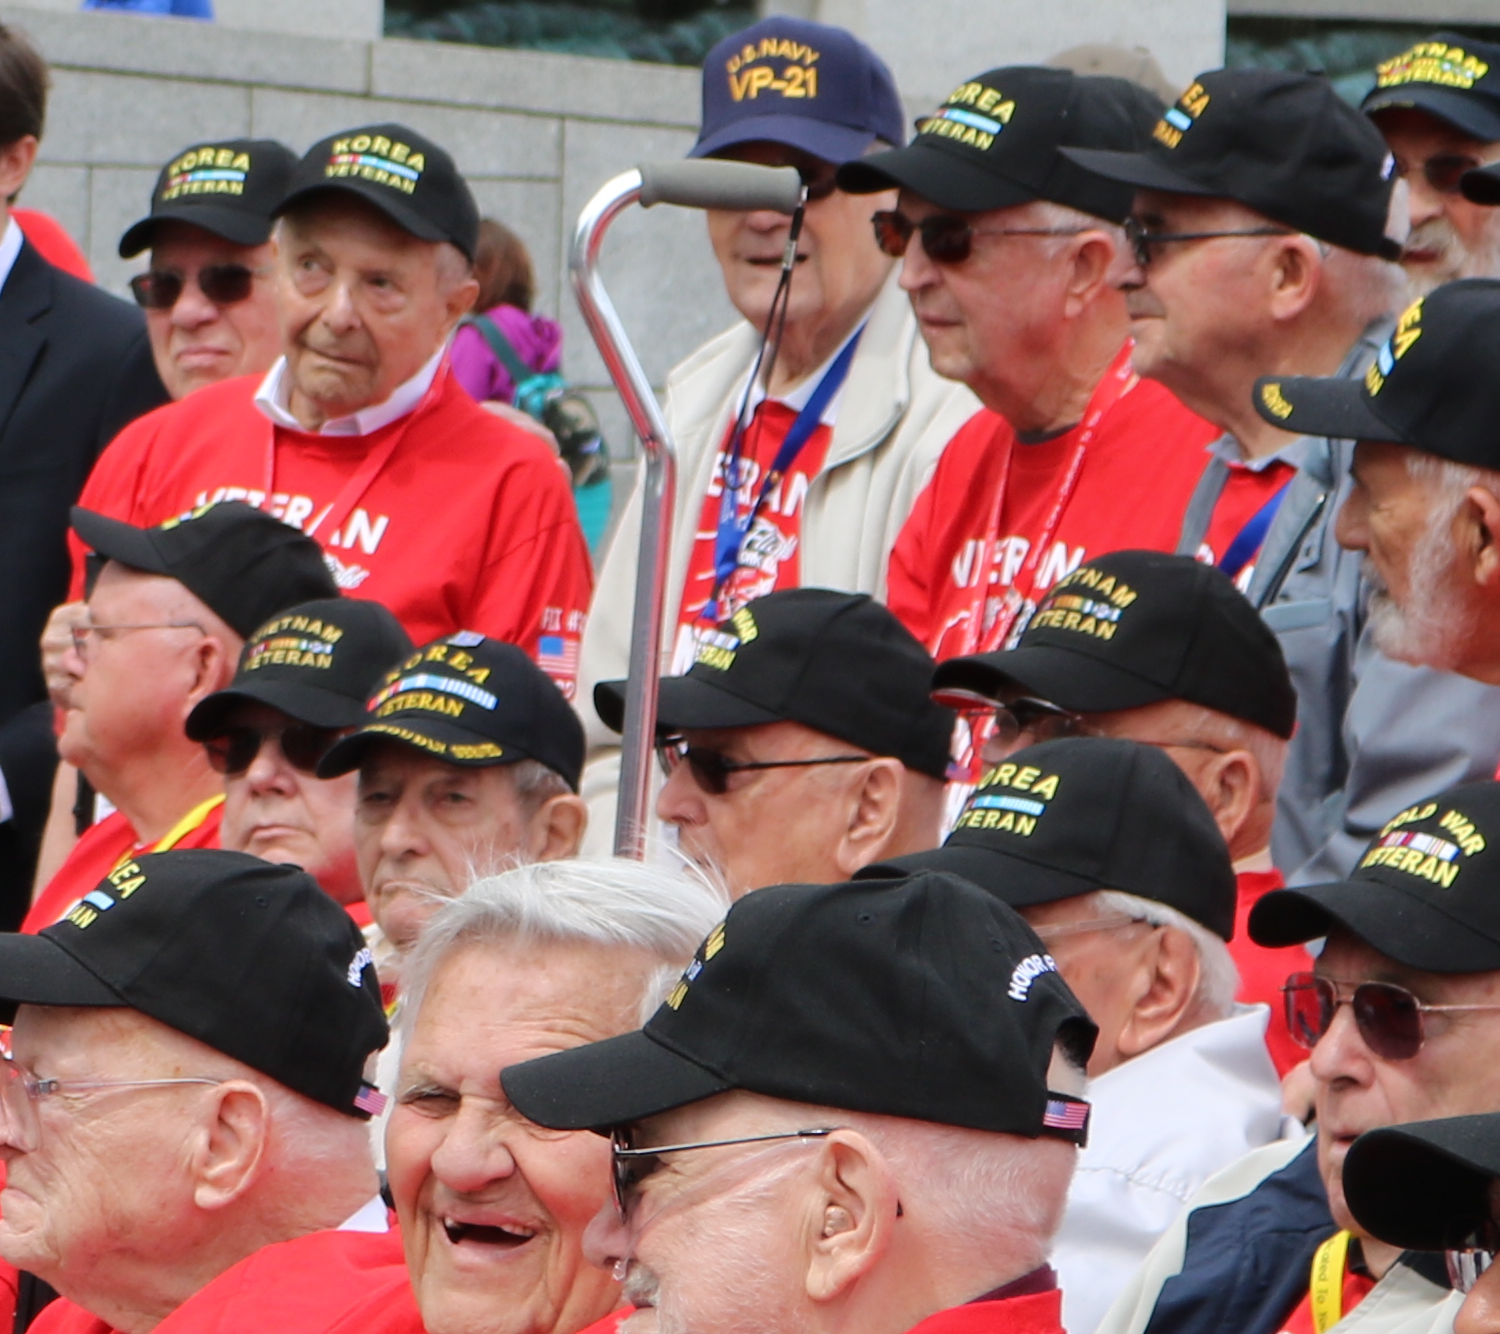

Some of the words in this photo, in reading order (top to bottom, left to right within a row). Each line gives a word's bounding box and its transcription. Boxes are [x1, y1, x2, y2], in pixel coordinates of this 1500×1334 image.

[760, 37, 821, 67] NAVY
[728, 66, 818, 103] VP-21
[950, 82, 1017, 125] OREA
[168, 146, 251, 179] KOREA
[332, 134, 426, 173] KOREA
[324, 164, 418, 196] VETERAN
[253, 616, 344, 644] VIETNAM
[244, 648, 333, 671] VETERAN
[385, 643, 493, 686] KOREA
[376, 691, 465, 719] VETERAN
[1379, 802, 1439, 839] COLD
[1438, 809, 1487, 858] WAR
[1360, 846, 1461, 889] VETERAN
